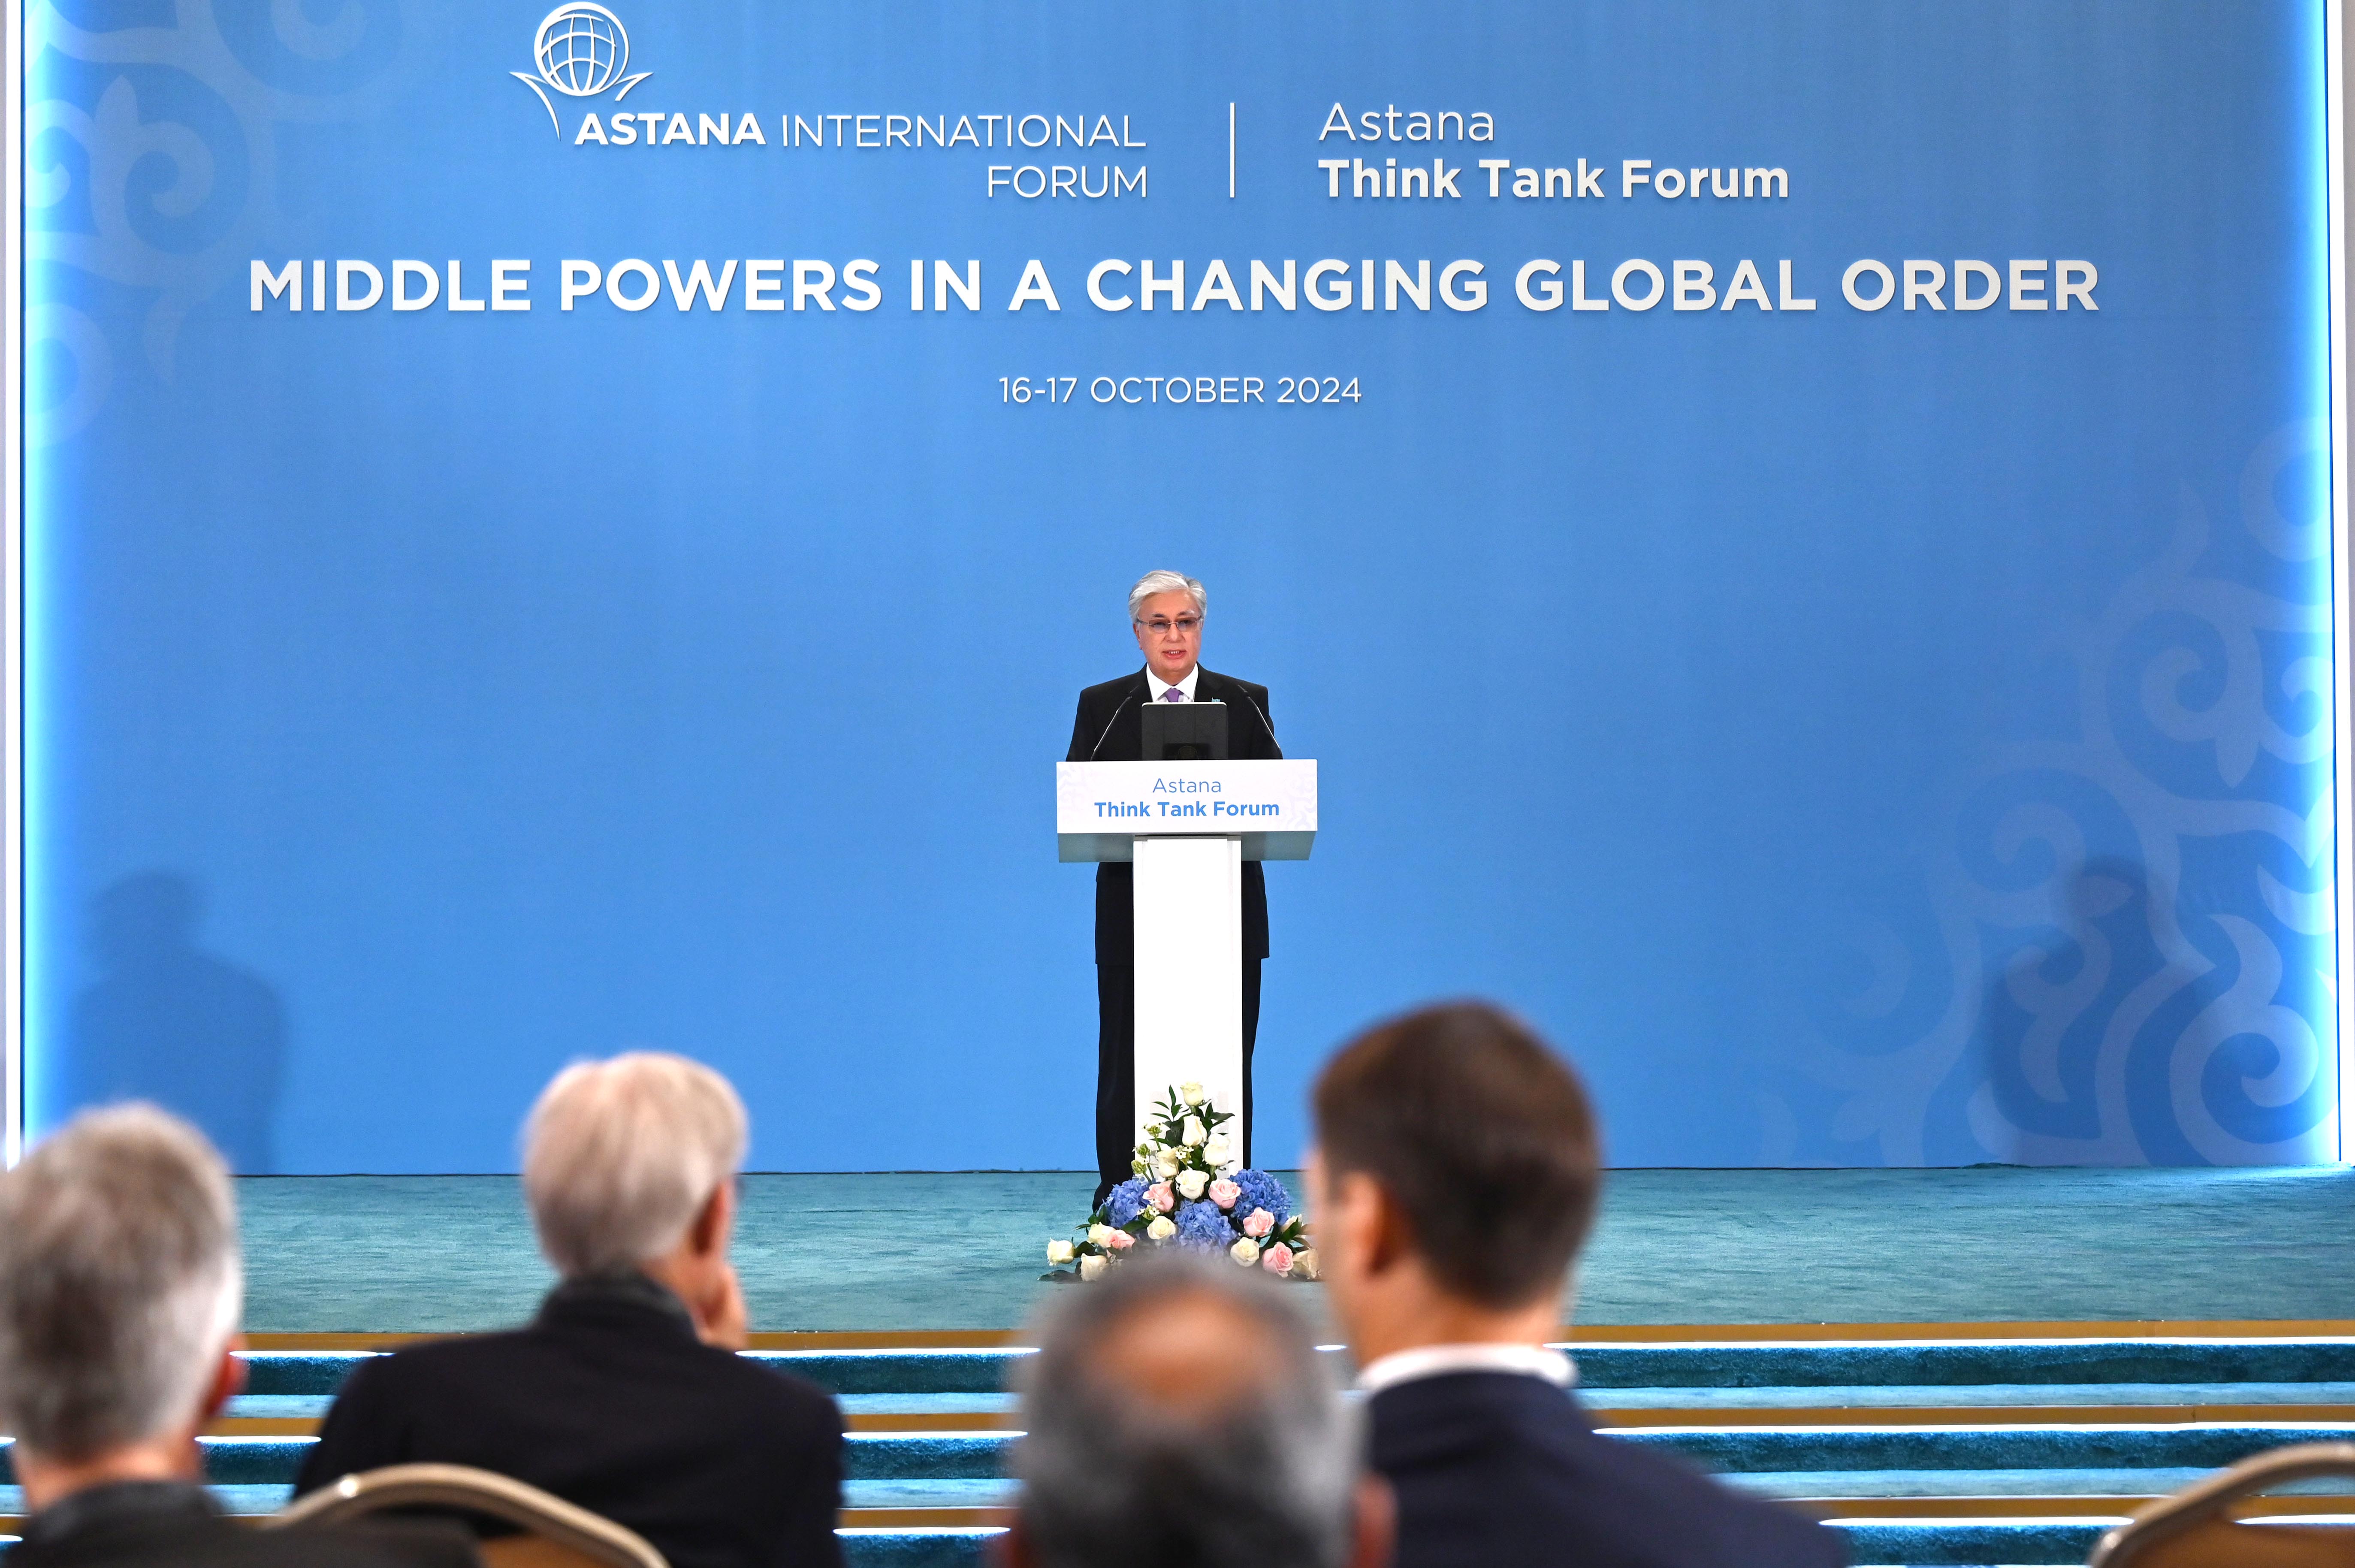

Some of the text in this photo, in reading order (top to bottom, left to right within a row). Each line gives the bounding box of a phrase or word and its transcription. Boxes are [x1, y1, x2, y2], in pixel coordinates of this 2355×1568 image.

[575, 113, 1147, 147] ASTANA INTERNATIONAL
[1320, 103, 1495, 141] Astana
[988, 166, 1147, 198] FORUM
[1319, 159, 1788, 198] Think Tank Forum
[251, 259, 2099, 312] MIDDLE POWERS IN A CHANGING GLOBAL ORDER
[999, 377, 1362, 403] 16-17 OCTOBER 2024
[1153, 778, 1222, 794] Astana
[1094, 801, 1280, 818] Think Tank Forum
